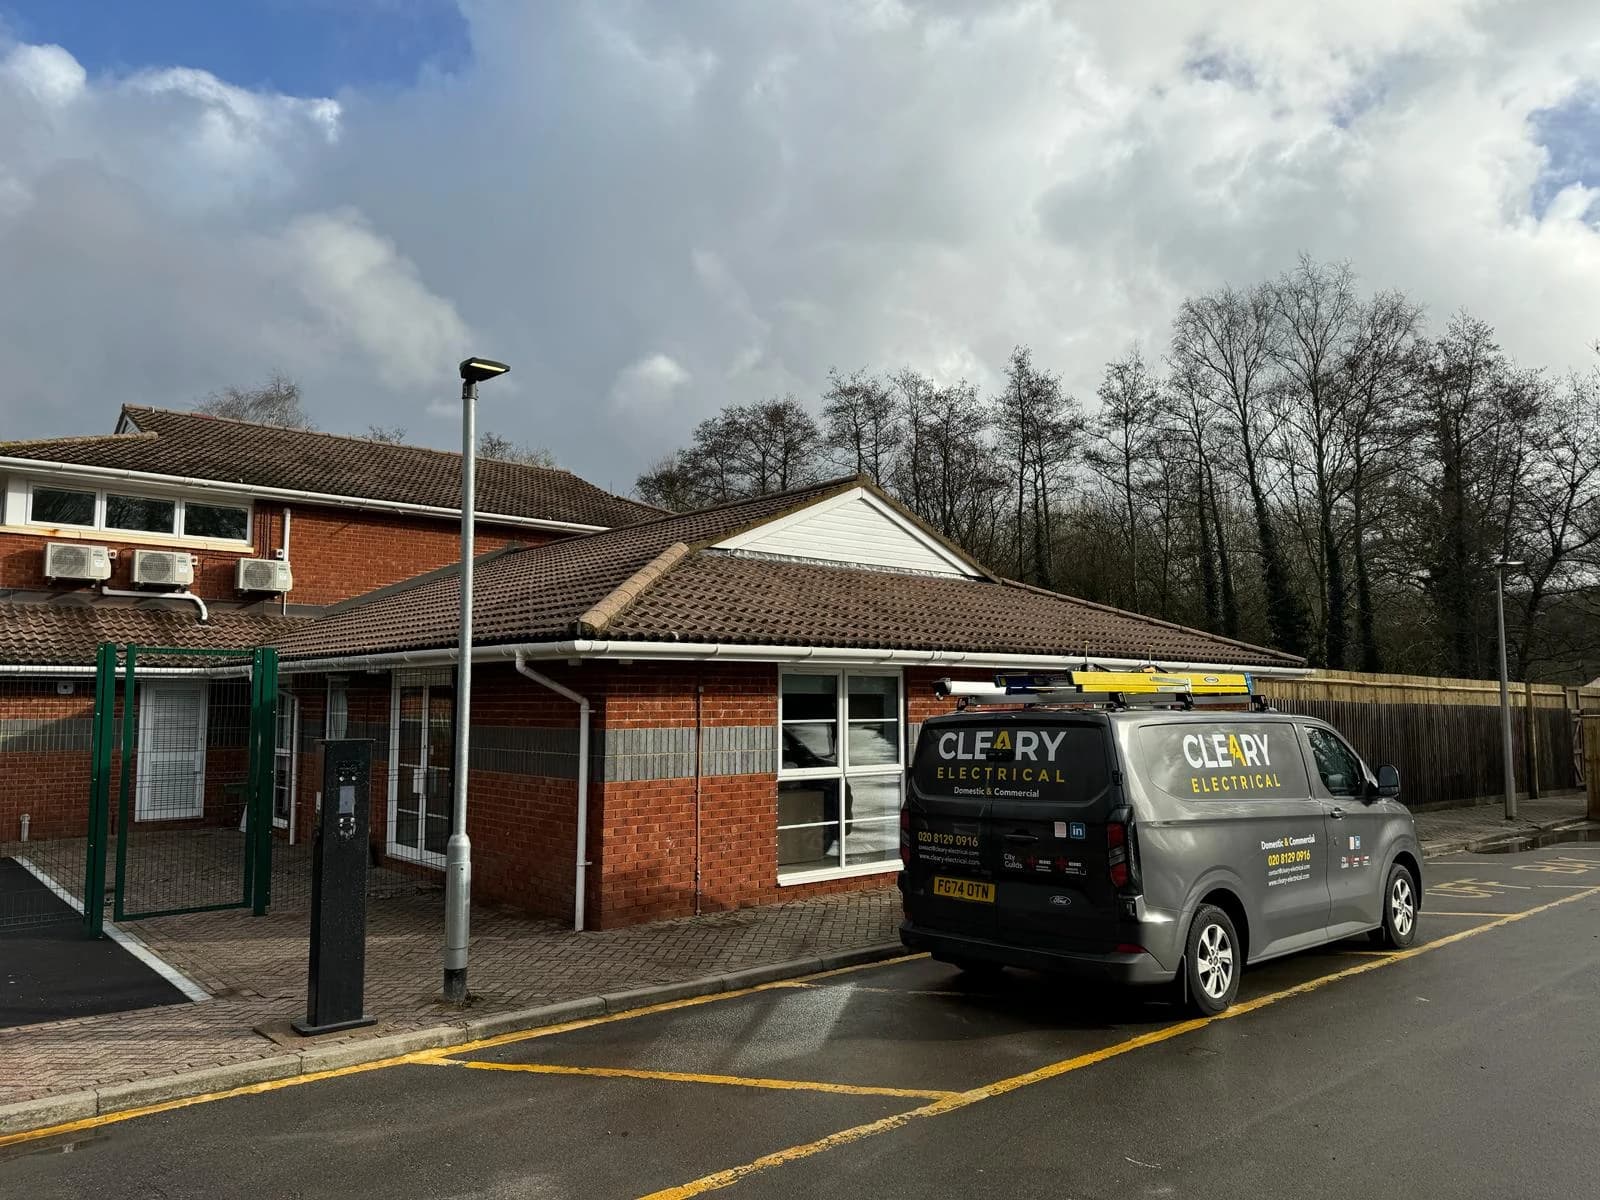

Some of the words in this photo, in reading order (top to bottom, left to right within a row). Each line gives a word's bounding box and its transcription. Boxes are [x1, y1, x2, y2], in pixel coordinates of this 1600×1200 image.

[938, 730, 1067, 761] CLEARY
[1183, 734, 1270, 768] CLEARY
[937, 766, 1065, 783] ELECTRICAL
[1191, 773, 1280, 793] ELECTRICAL
[954, 786, 984, 796] Domestic
[986, 787, 993, 796] &
[994, 787, 1040, 798] Commercial
[918, 831, 932, 843] 020
[933, 832, 954, 845] 8129
[956, 835, 979, 848] 0916
[1261, 838, 1284, 850] Domestic
[1284, 838, 1289, 847] &
[1289, 834, 1315, 846] Commercial
[1268, 854, 1279, 866] 020
[1280, 852, 1295, 864] 8129
[1296, 849, 1311, 861] 0916
[937, 879, 965, 896] FG74
[967, 883, 989, 899] OTN
